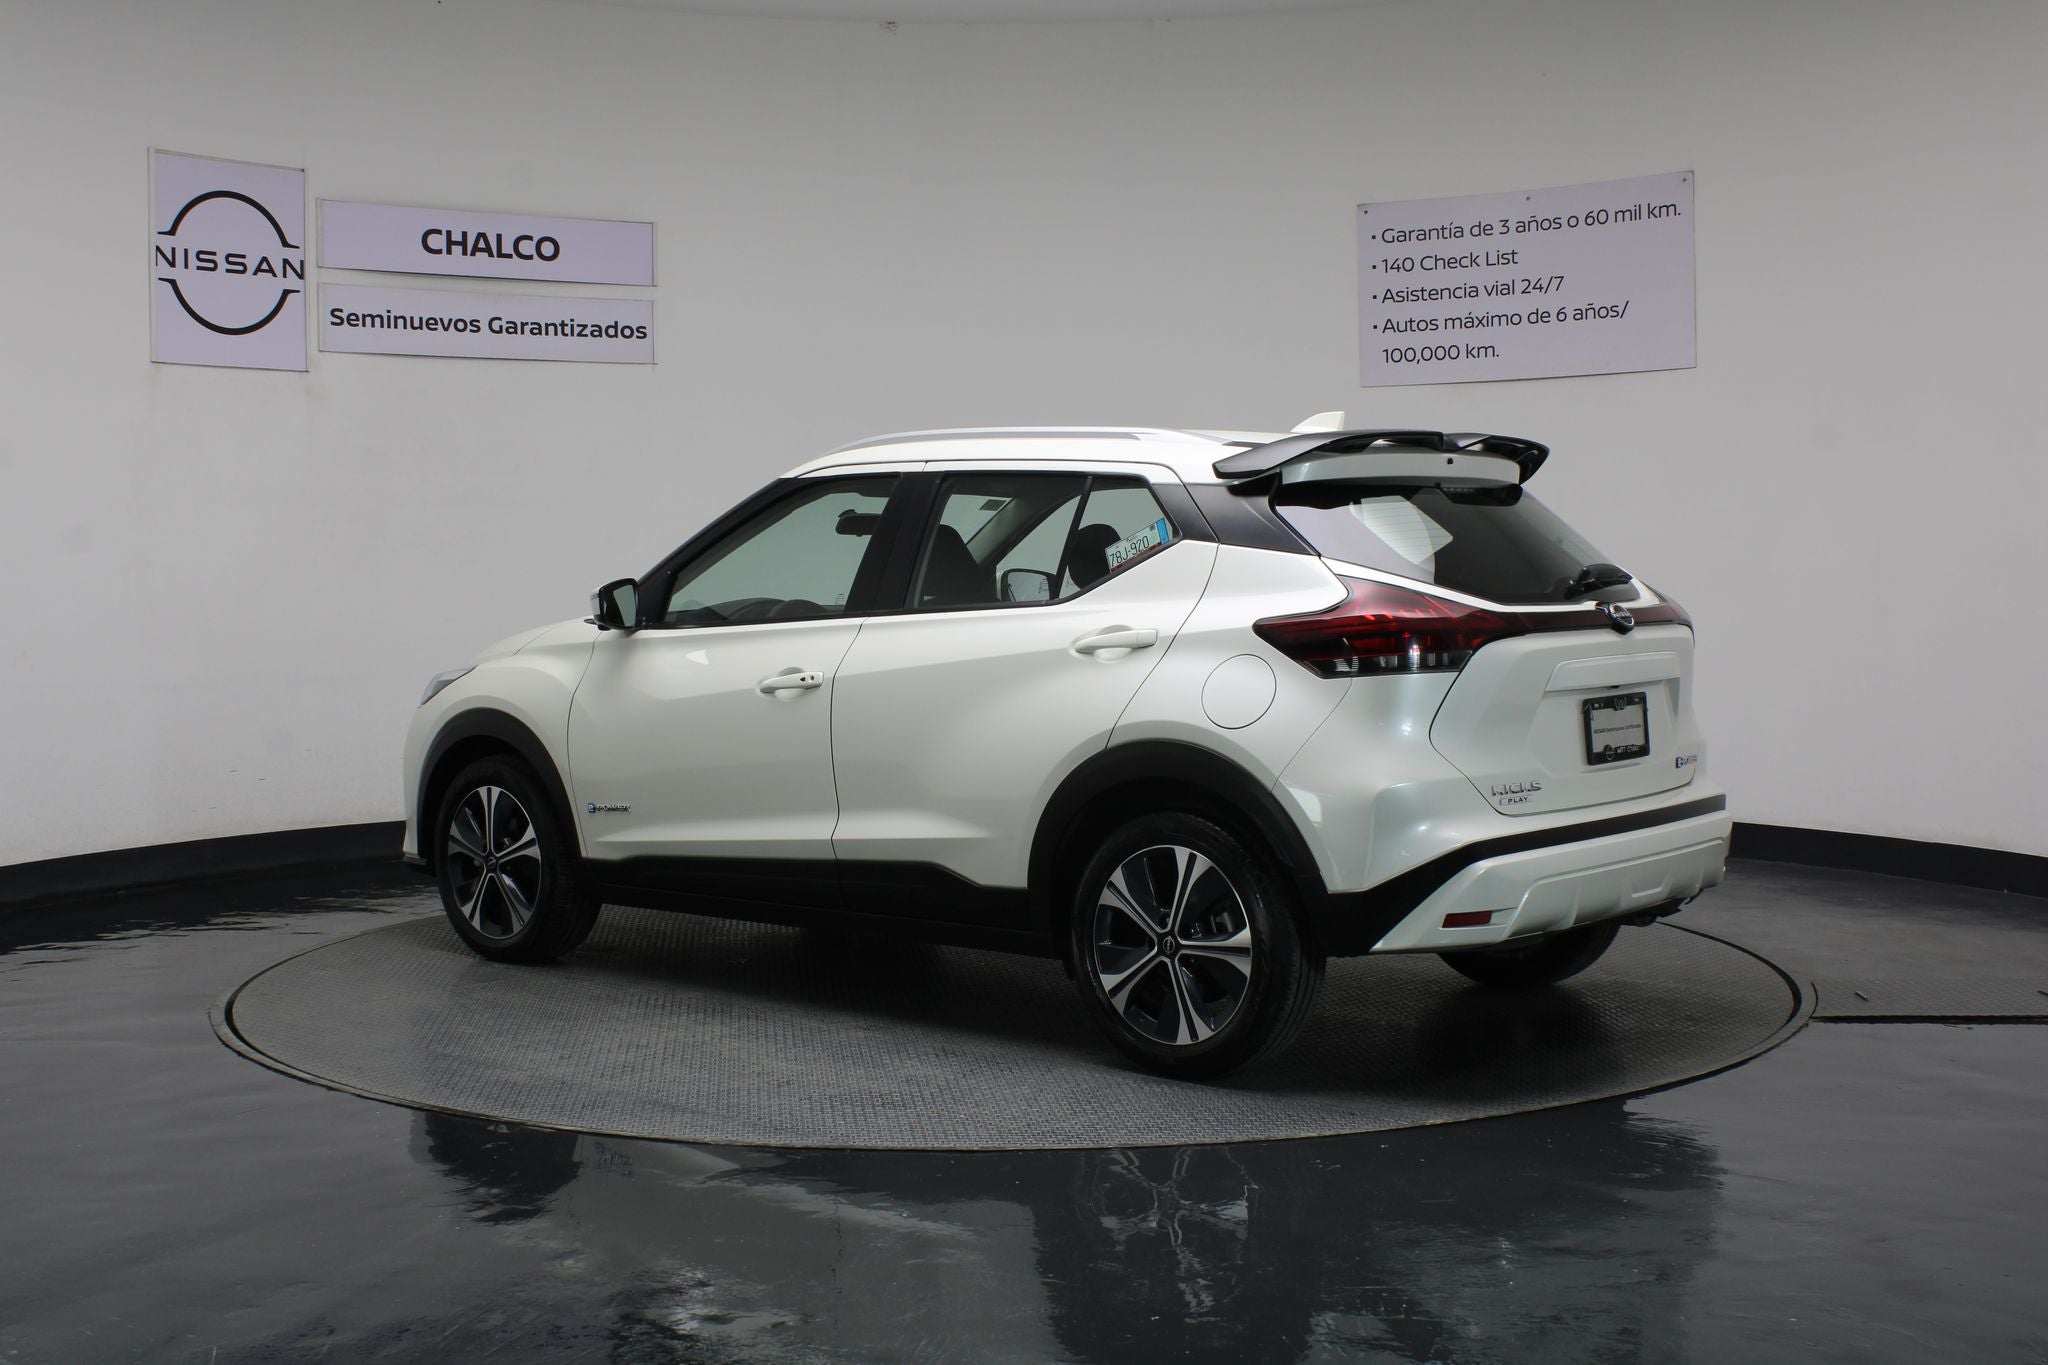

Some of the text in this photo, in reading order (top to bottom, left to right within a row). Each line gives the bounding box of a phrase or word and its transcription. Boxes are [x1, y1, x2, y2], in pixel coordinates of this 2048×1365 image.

[1381, 202, 1682, 244] Garantía de 3 años o 60 mil km.
[420, 228, 561, 262] CHALCO
[1381, 248, 1519, 274] 140 Check List
[155, 244, 305, 281] NISSAN
[1381, 275, 1565, 304] Asistencia vial 24/7
[329, 307, 648, 340] Seminuevos Garantizados
[1381, 299, 1630, 334] Autos máximo de 6 años/
[1382, 343, 1500, 365] 100,000 km.
[1108, 535, 1151, 568] 78J-920
[1491, 780, 1542, 797] KICKS
[1507, 796, 1529, 804] PLAY
